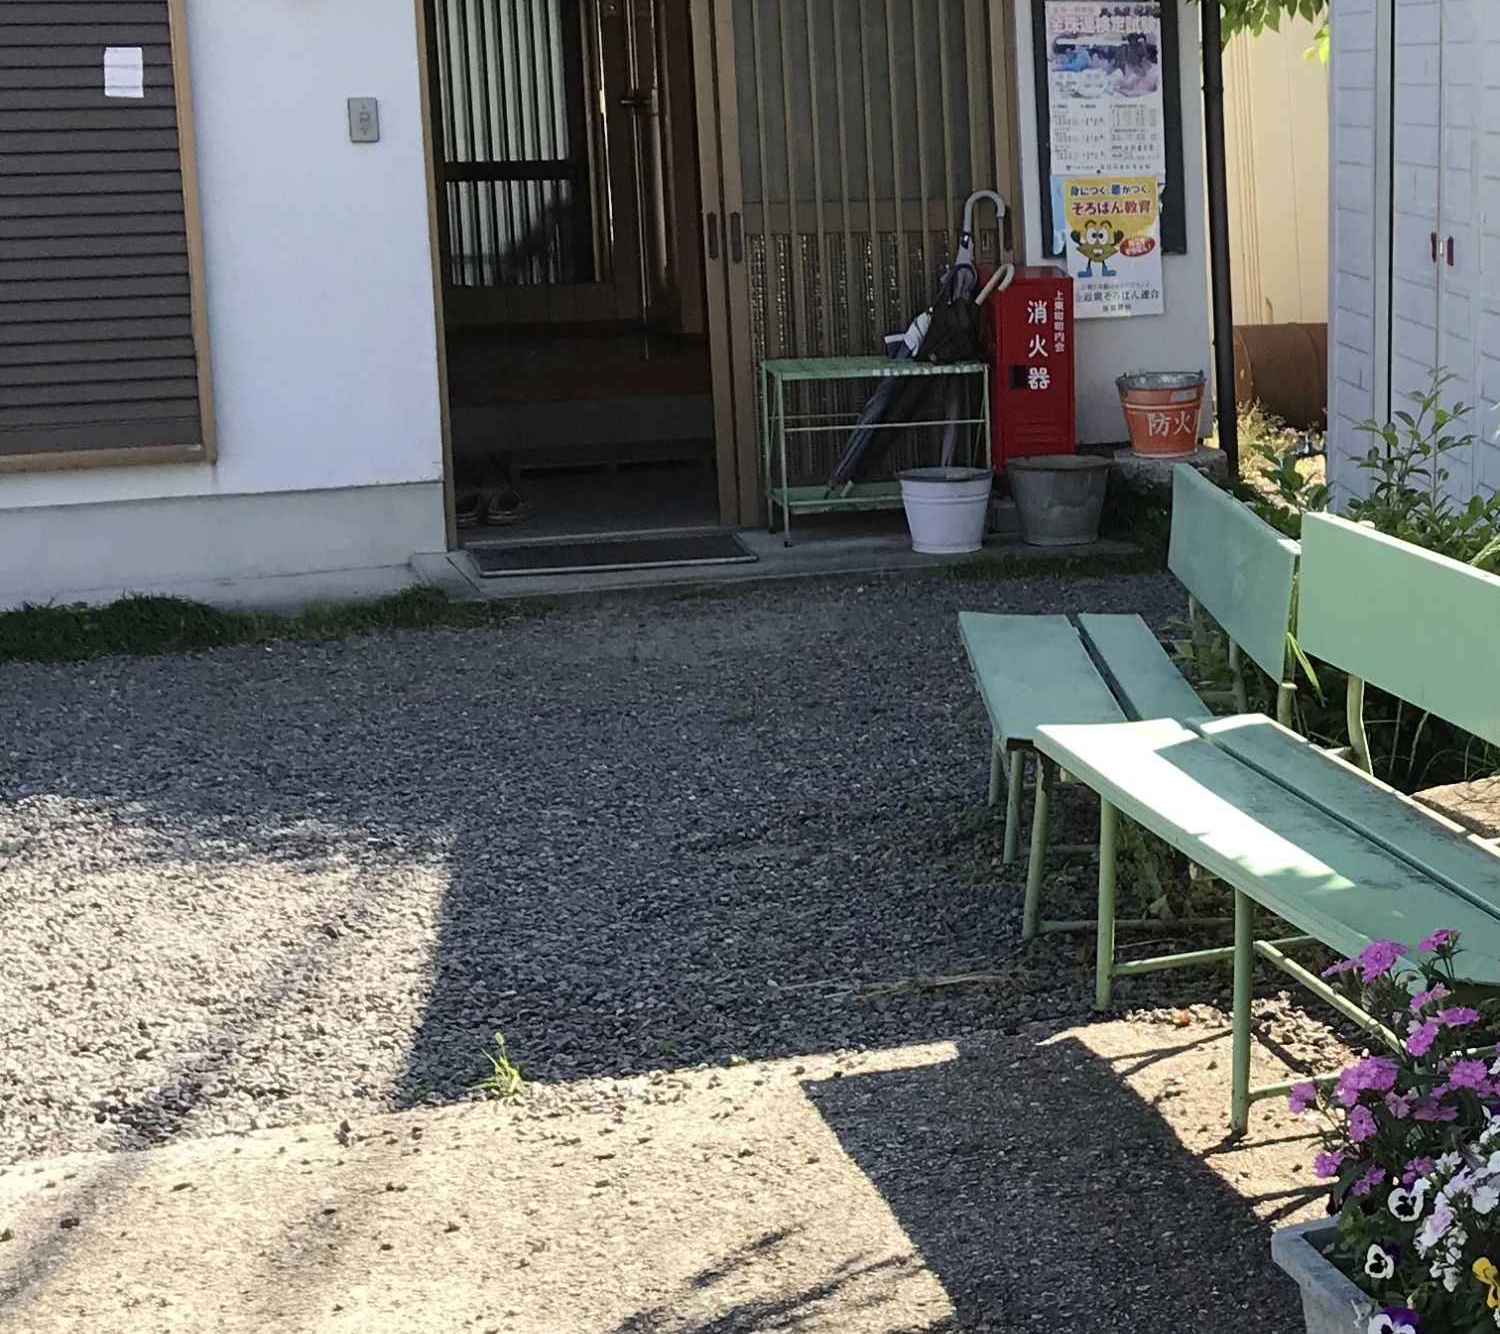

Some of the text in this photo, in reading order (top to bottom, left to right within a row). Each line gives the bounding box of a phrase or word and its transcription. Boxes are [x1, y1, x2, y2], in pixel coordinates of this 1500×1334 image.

[1027, 299, 1051, 390] 消火器
[1053, 289, 1065, 353] 上東町町内会
[1147, 410, 1199, 437] 防火
